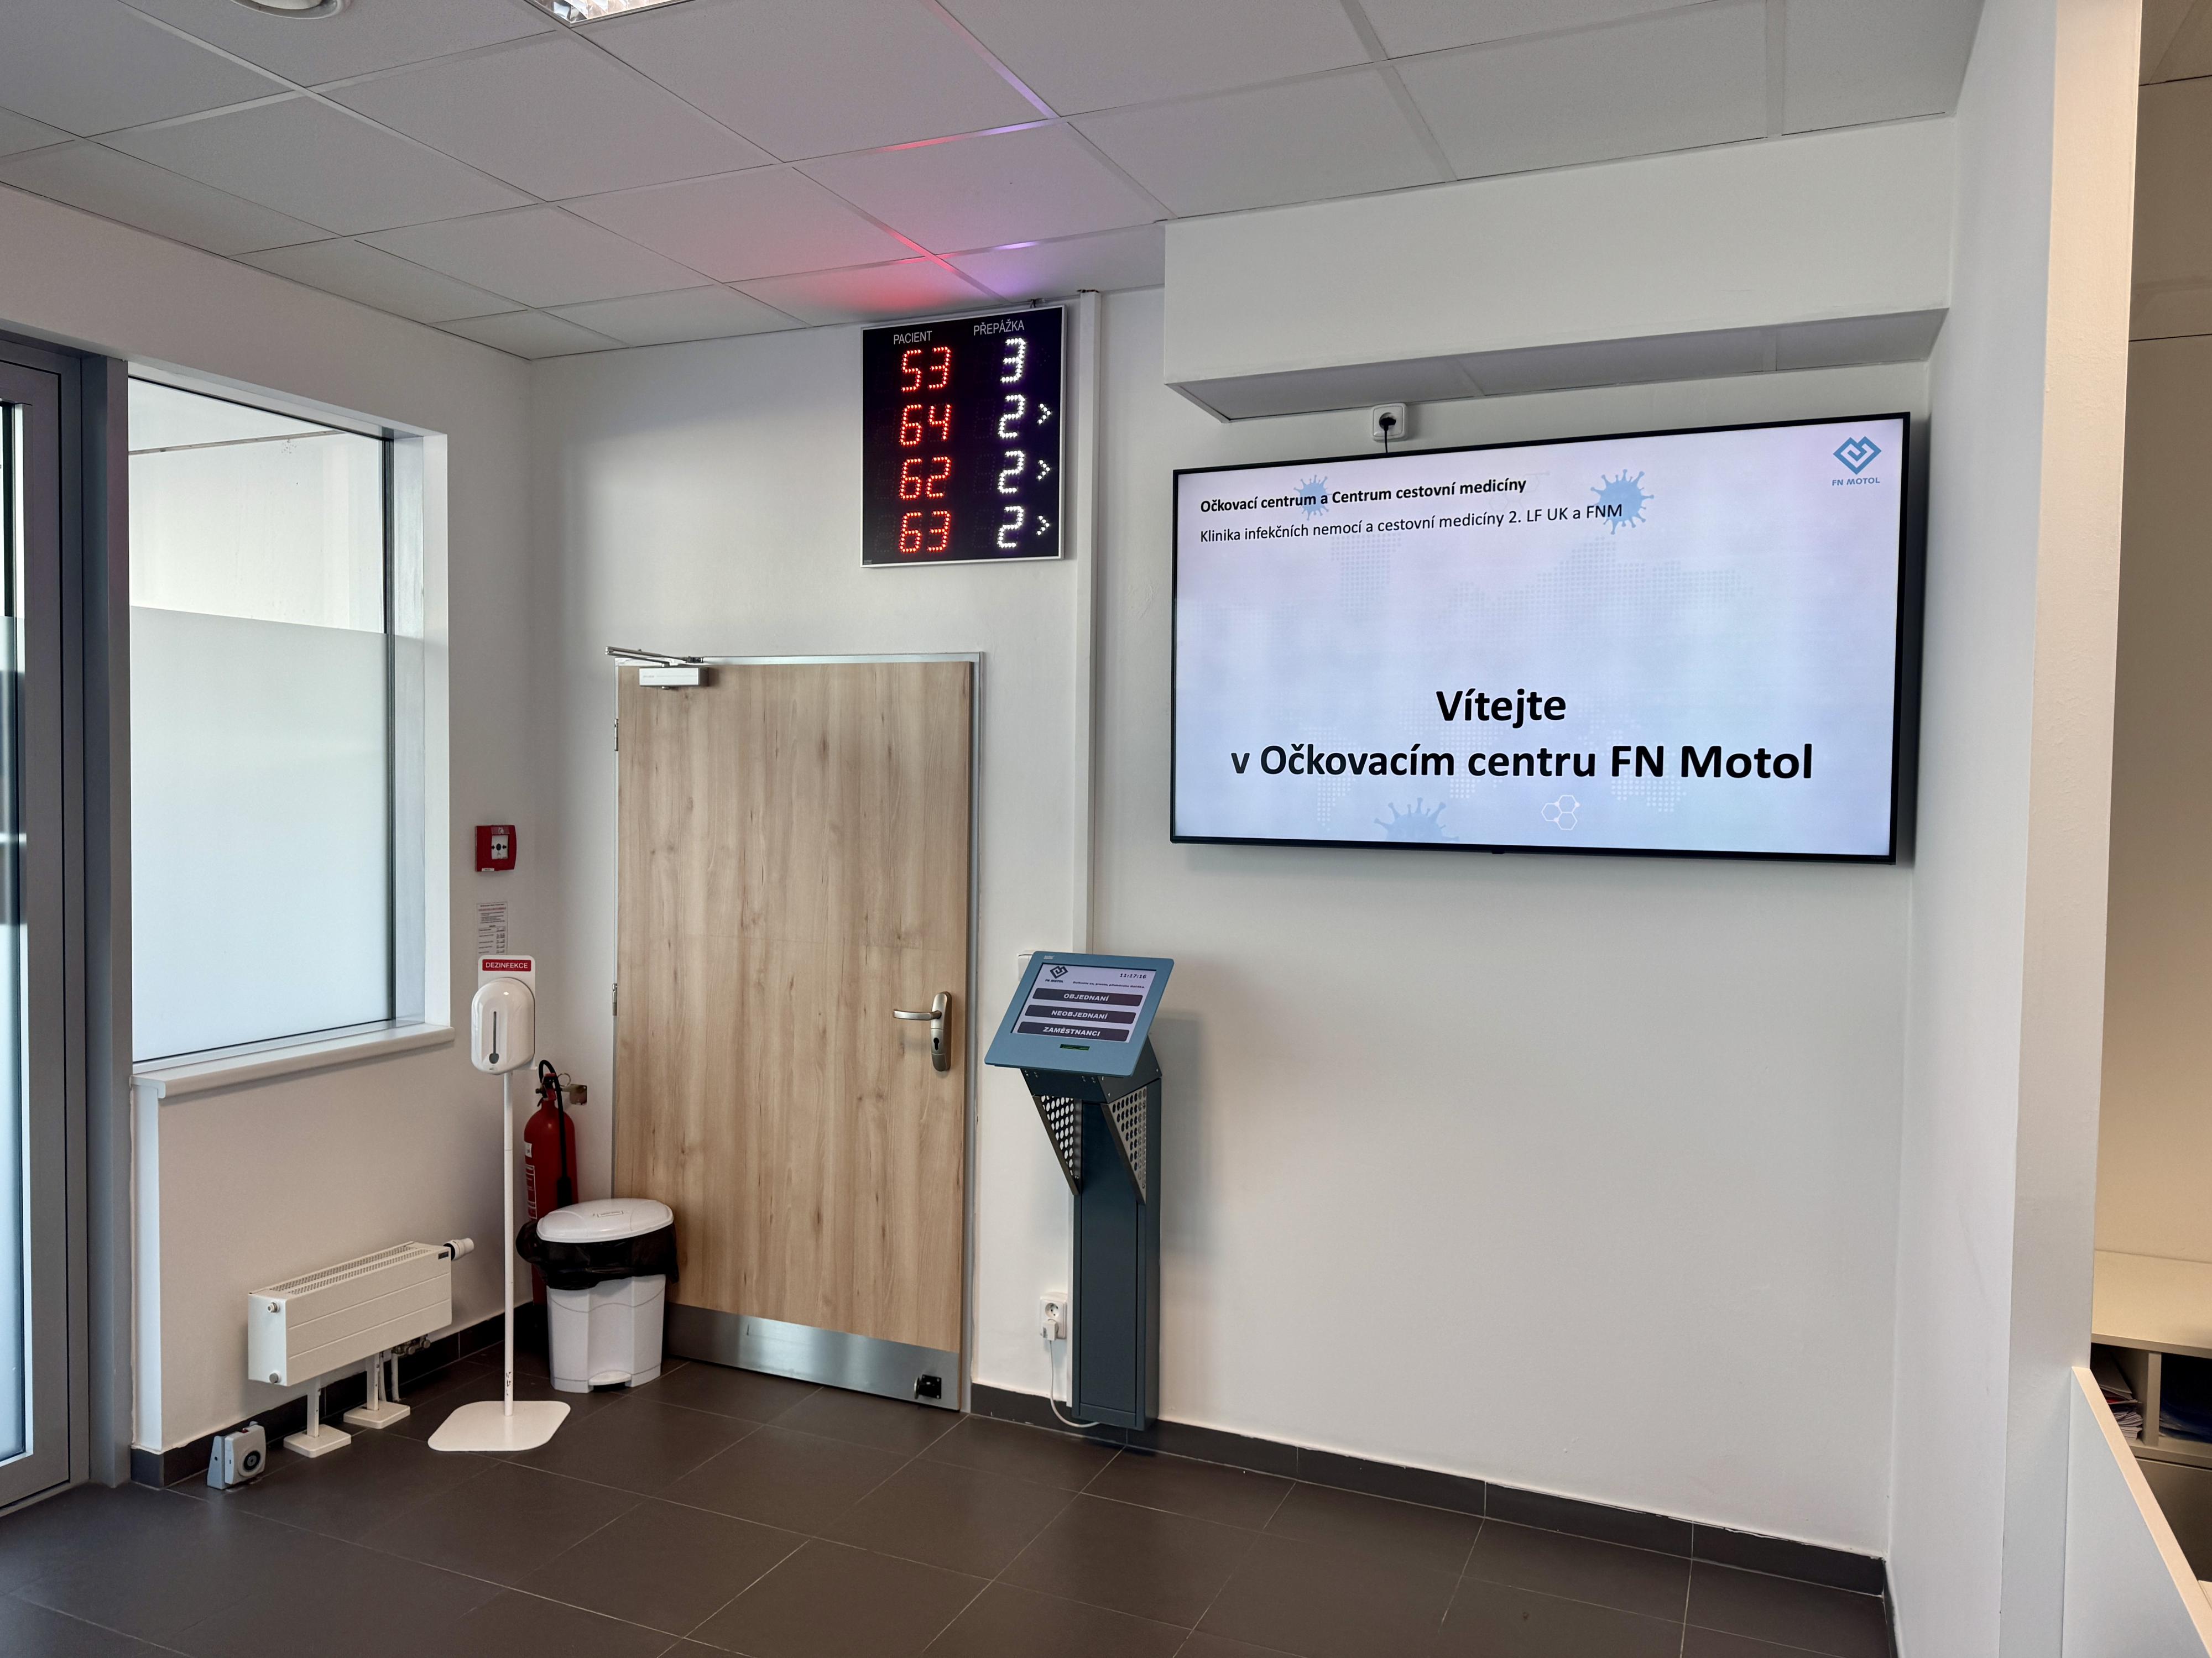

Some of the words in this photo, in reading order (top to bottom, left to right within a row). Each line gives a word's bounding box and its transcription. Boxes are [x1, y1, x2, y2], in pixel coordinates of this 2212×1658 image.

[893, 330, 932, 345] PACIENT
[973, 319, 1025, 336] PŘEPÁŽKA
[901, 346, 952, 392] 53
[1000, 337, 1027, 384] 3
[899, 403, 952, 447] 64
[998, 394, 1026, 440] 2
[899, 456, 952, 500] 62
[998, 450, 1025, 494] 2
[1846, 477, 1880, 485] MOTOL
[1201, 496, 1258, 512] Očkovací
[1261, 495, 1316, 509] centrum
[1320, 495, 1328, 504] a
[1332, 490, 1391, 504] Centrum
[1396, 482, 1455, 499] cestovní
[1459, 478, 1526, 494] medicíny
[898, 510, 951, 553] 63
[997, 505, 1025, 549] 2
[1201, 527, 1240, 542] Klinika
[1245, 523, 1308, 540] infekčních
[1313, 520, 1363, 536] nemocí
[1366, 523, 1373, 532] a
[1378, 515, 1436, 532] cestovní
[1439, 511, 1504, 528] medicíny
[1509, 510, 1522, 524] 2.
[1527, 509, 1542, 522] LF
[1547, 507, 1568, 521] UK
[1573, 509, 1580, 519] a
[1587, 504, 1623, 519] FNM
[1436, 688, 1566, 729] Vítejte
[1231, 752, 1250, 774] v
[1261, 743, 1454, 776] Očkovacím
[1468, 748, 1595, 777] centru
[1611, 745, 1664, 778] FN
[1681, 743, 1812, 779] Motol
[1051, 1010, 1108, 1019] NEOBJEDNANÍ
[1063, 993, 1109, 1002] OBJEDNANÍ
[1042, 1027, 1101, 1037] ZAMĚSTNANCI
